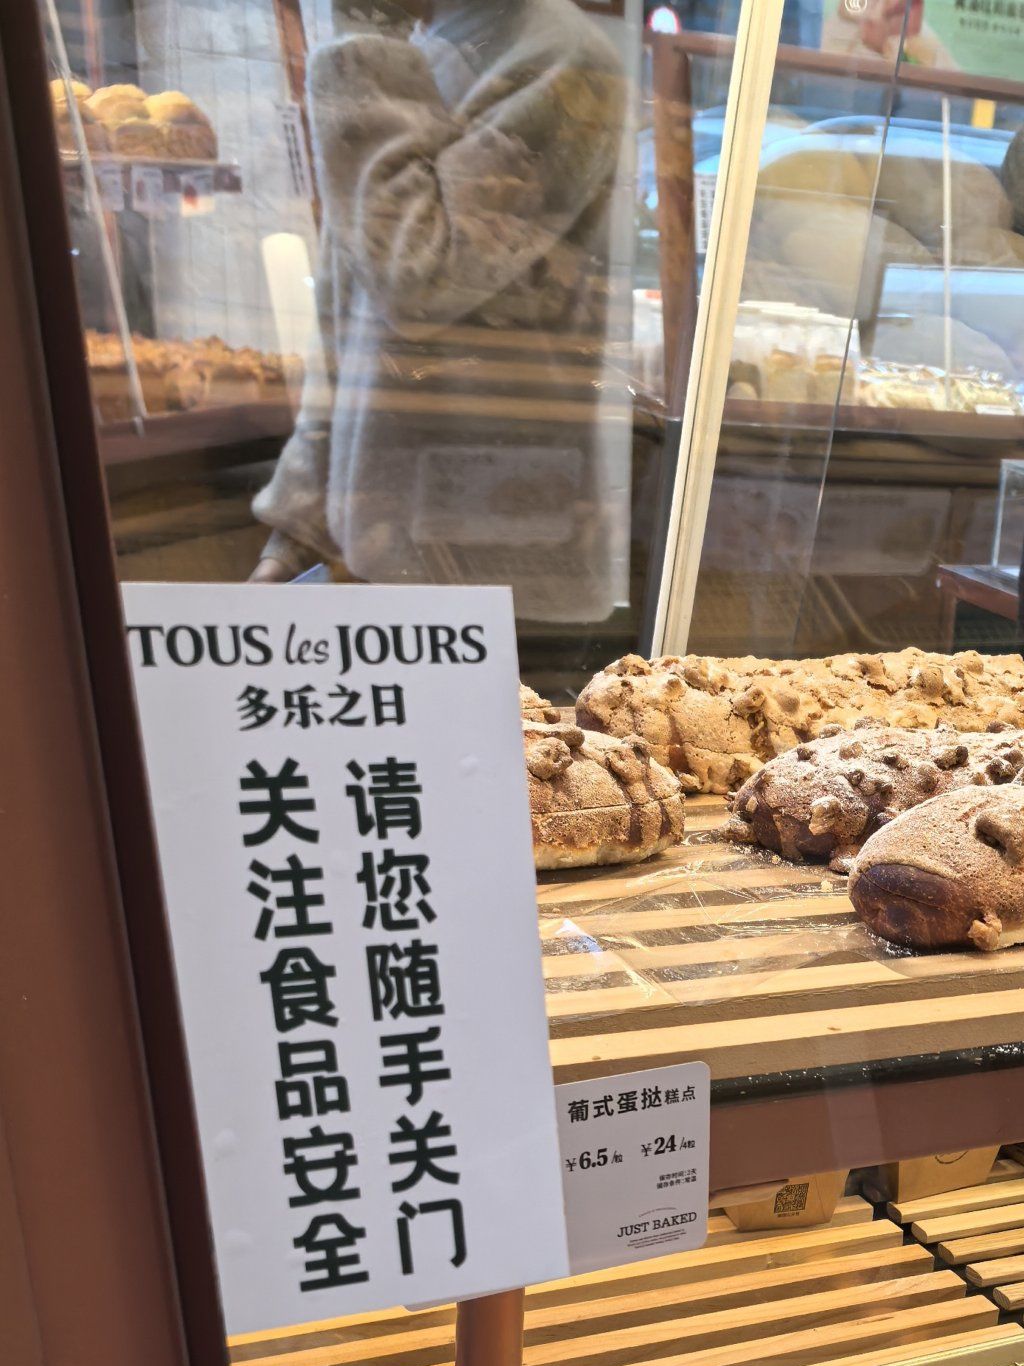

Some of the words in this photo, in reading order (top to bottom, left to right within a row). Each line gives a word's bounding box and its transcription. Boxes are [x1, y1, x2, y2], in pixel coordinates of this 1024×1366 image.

[125, 625, 274, 667] TOUS
[284, 623, 330, 665] les
[335, 624, 488, 675] JOURS
[236, 684, 406, 731] 多乐之日
[238, 757, 370, 1292] 关注食品安全
[345, 756, 468, 1276] 请您随手关门
[567, 1085, 697, 1123] 葡式蛋挞糕点
[617, 1221, 650, 1238] JUST
[652, 1211, 698, 1231] BAKED
